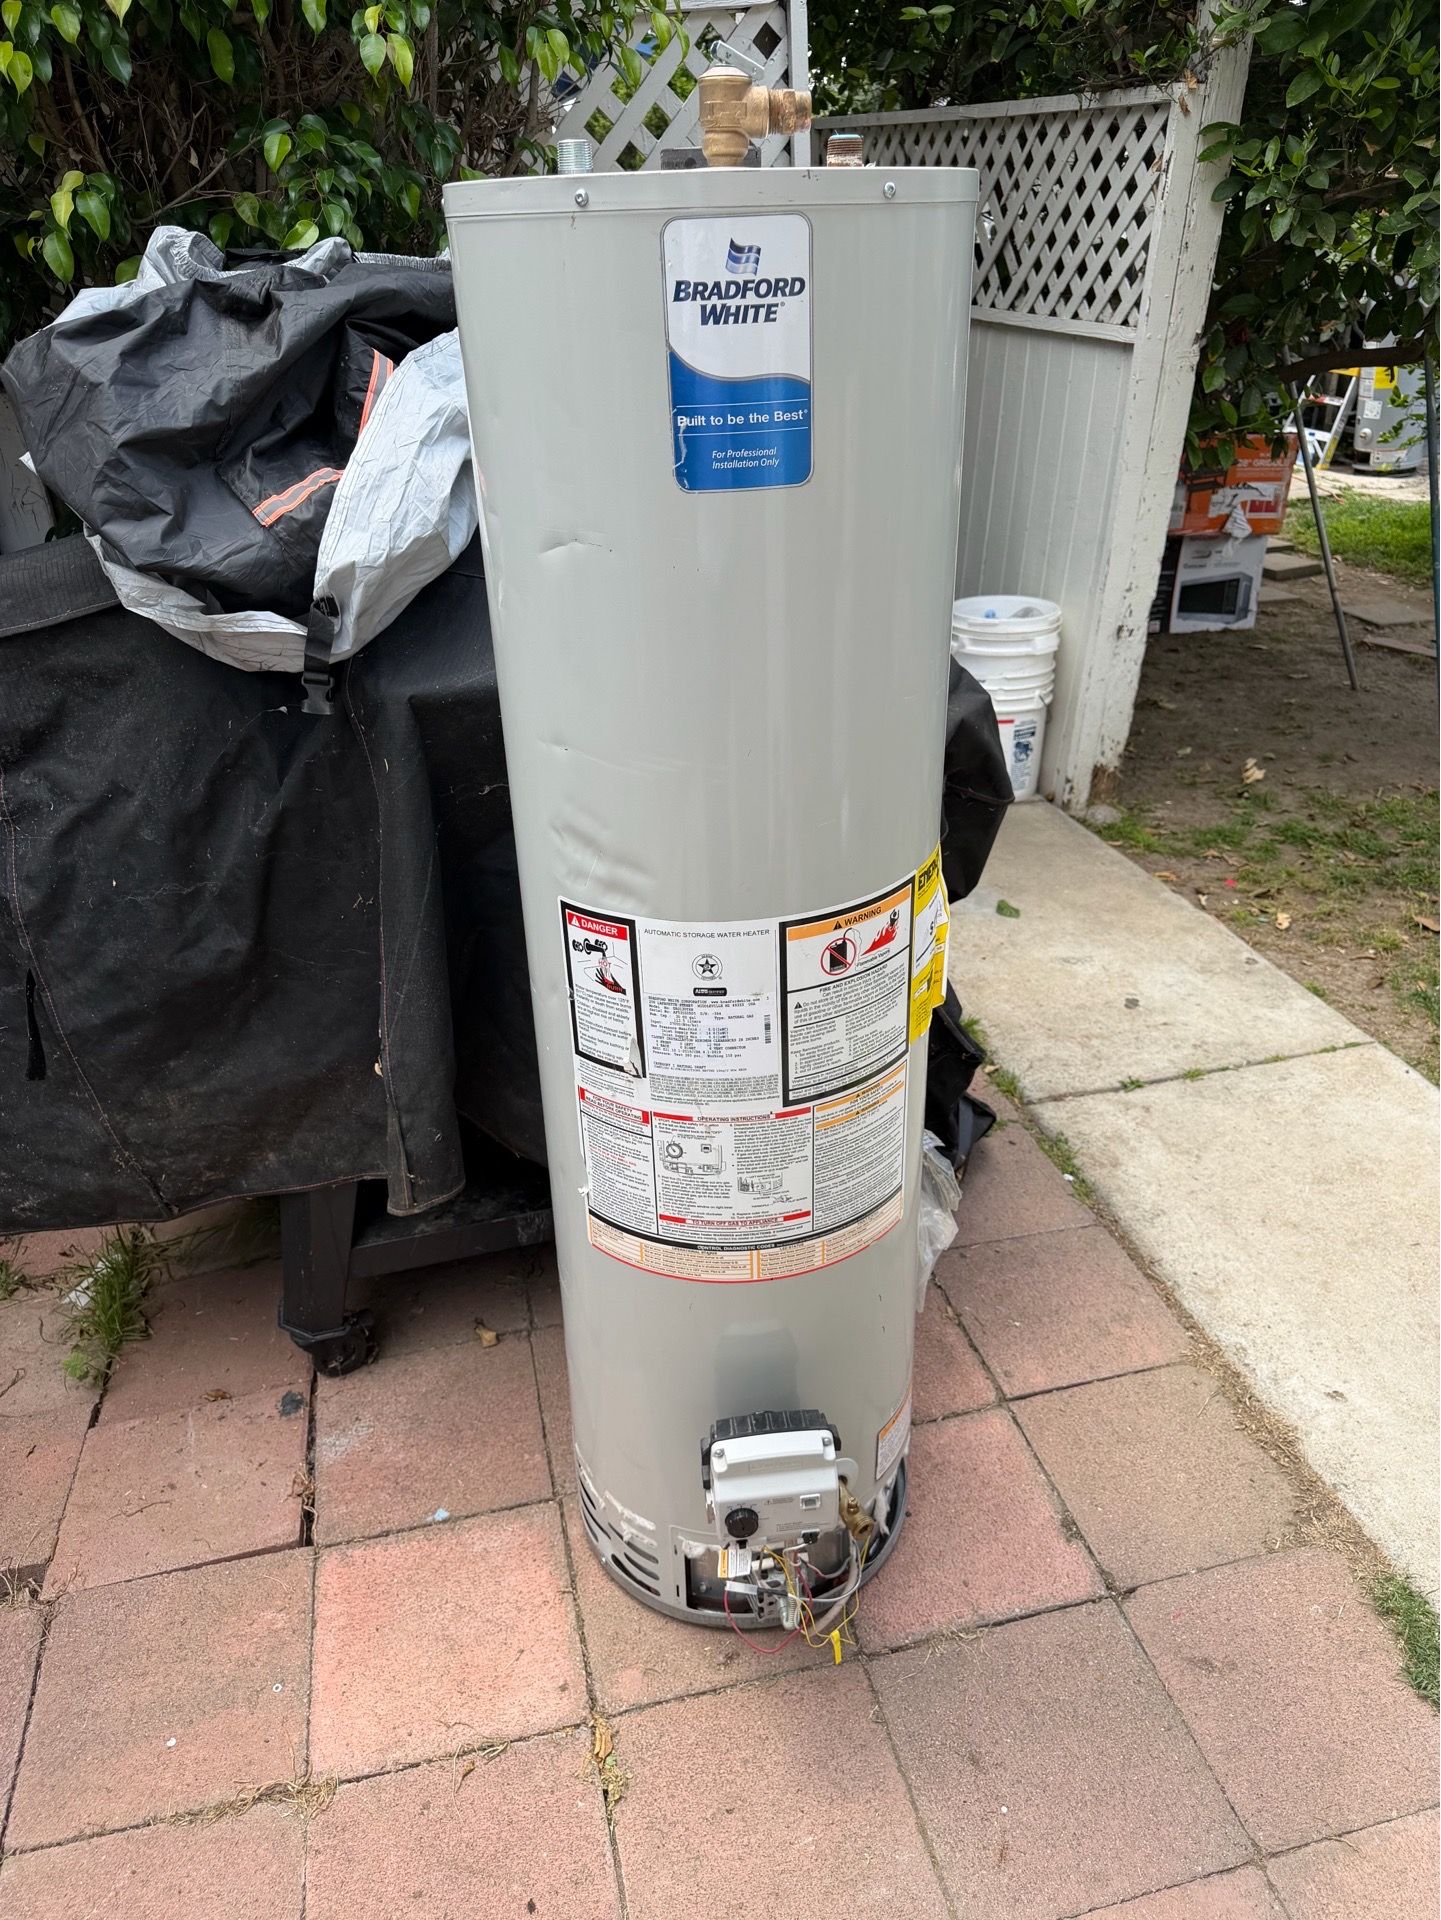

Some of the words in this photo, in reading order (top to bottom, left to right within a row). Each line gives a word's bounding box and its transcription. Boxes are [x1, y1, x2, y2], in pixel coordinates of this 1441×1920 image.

[672, 276, 806, 302] BRADFORD
[678, 416, 706, 426] Built
[710, 416, 723, 426] to
[727, 414, 744, 424] be
[749, 412, 769, 424] the
[712, 450, 725, 460] For
[726, 447, 776, 458] Professional
[712, 458, 759, 469] Installation
[760, 458, 780, 468] Only
[844, 906, 882, 926] WARNING
[580, 920, 618, 936] DANGER
[644, 928, 682, 938] AUTOMATIC
[598, 960, 612, 968] HOT
[844, 972, 870, 985] EXPLOSION
[871, 964, 888, 975] HAZARD
